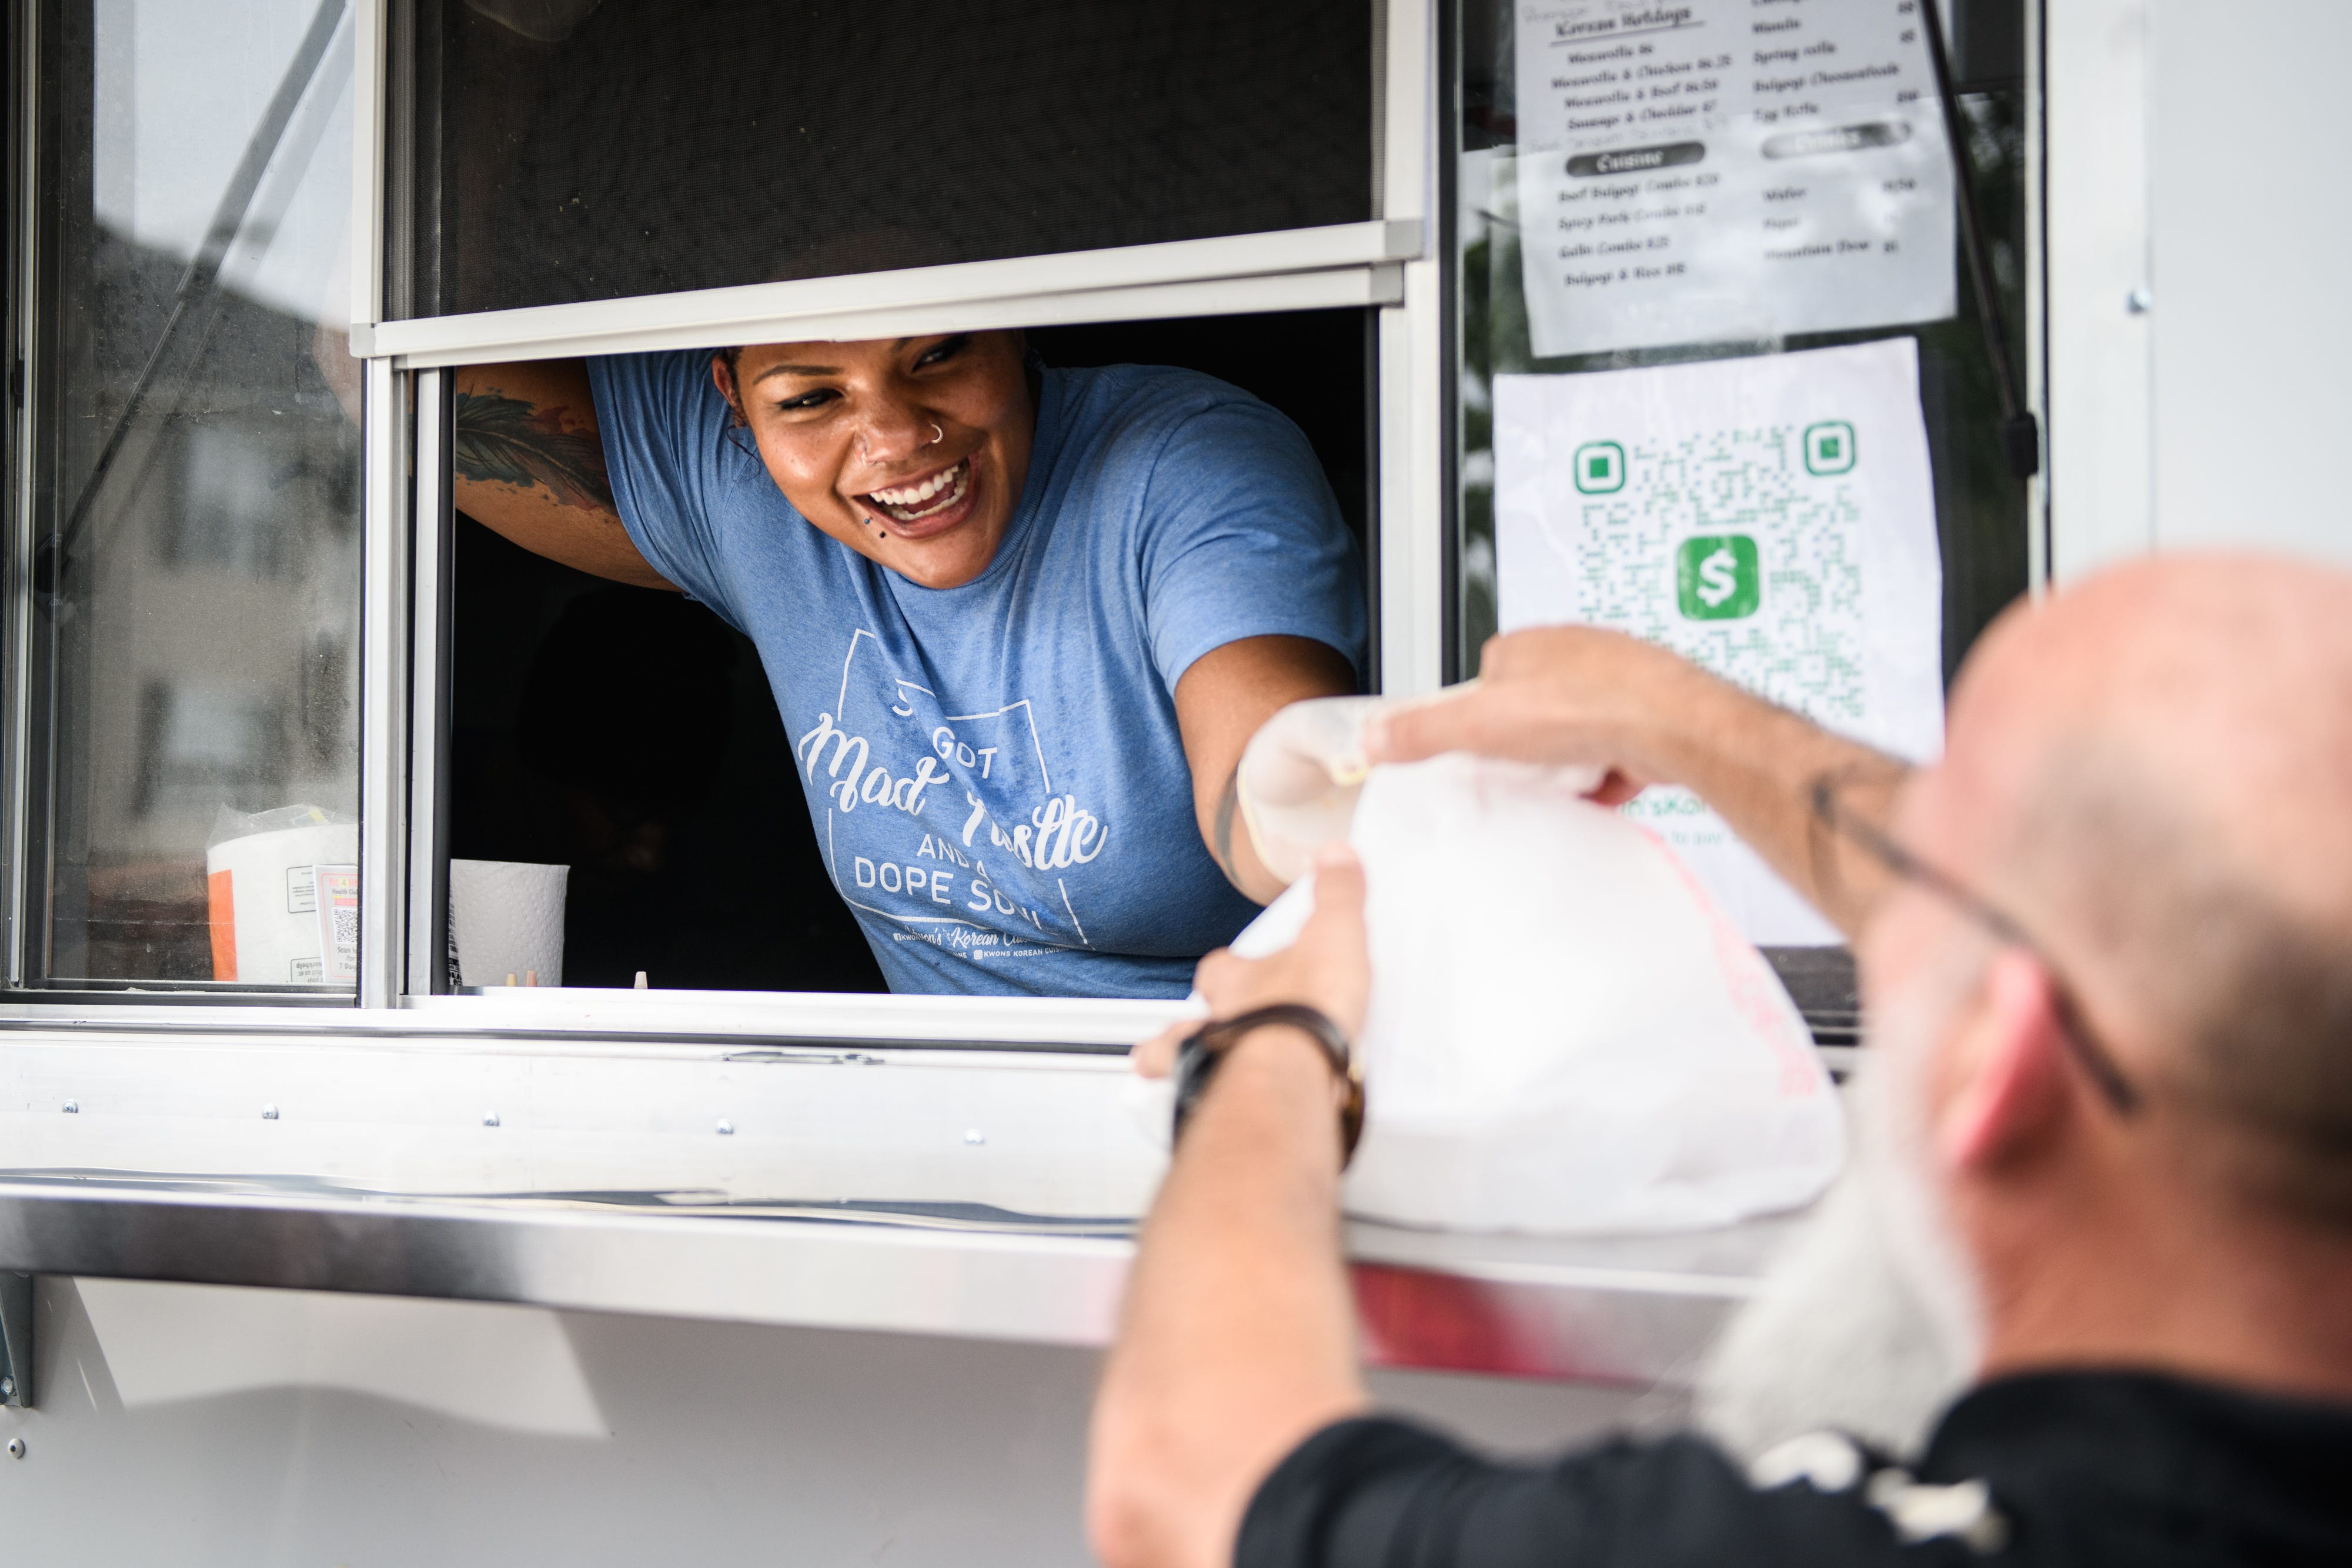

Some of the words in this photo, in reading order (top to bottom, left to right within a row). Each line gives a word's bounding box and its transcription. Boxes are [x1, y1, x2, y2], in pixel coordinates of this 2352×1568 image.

[1596, 151, 1664, 173] Cuisine
[798, 712, 950, 816] Mad
[933, 726, 998, 779] GOT
[916, 833, 970, 868] AND
[855, 855, 954, 904] DOPE
[950, 927, 999, 948] Korean
[1013, 948, 1043, 957] KOREAN
